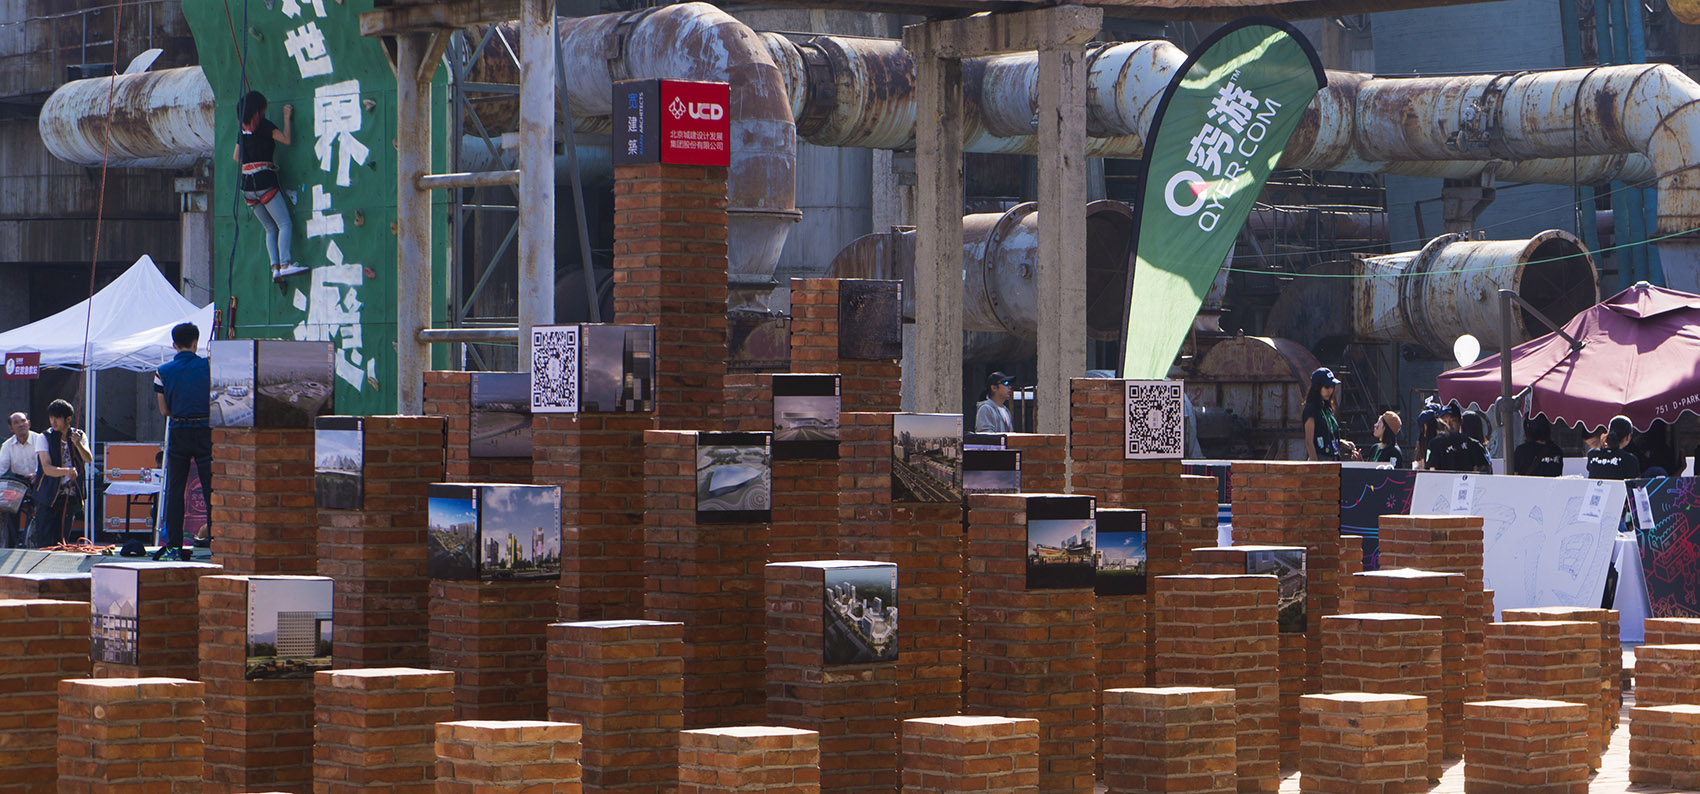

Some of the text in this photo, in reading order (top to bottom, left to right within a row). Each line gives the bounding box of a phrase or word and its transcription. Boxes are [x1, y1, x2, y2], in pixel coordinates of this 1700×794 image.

[688, 102, 724, 120] UCD
[670, 130, 723, 141] 北京城建设计发展
[1186, 81, 1259, 176] 穷游
[670, 141, 723, 151] 集团股份有限公司
[1198, 98, 1282, 232] QYER.COM
[1655, 404, 1669, 415] 751
